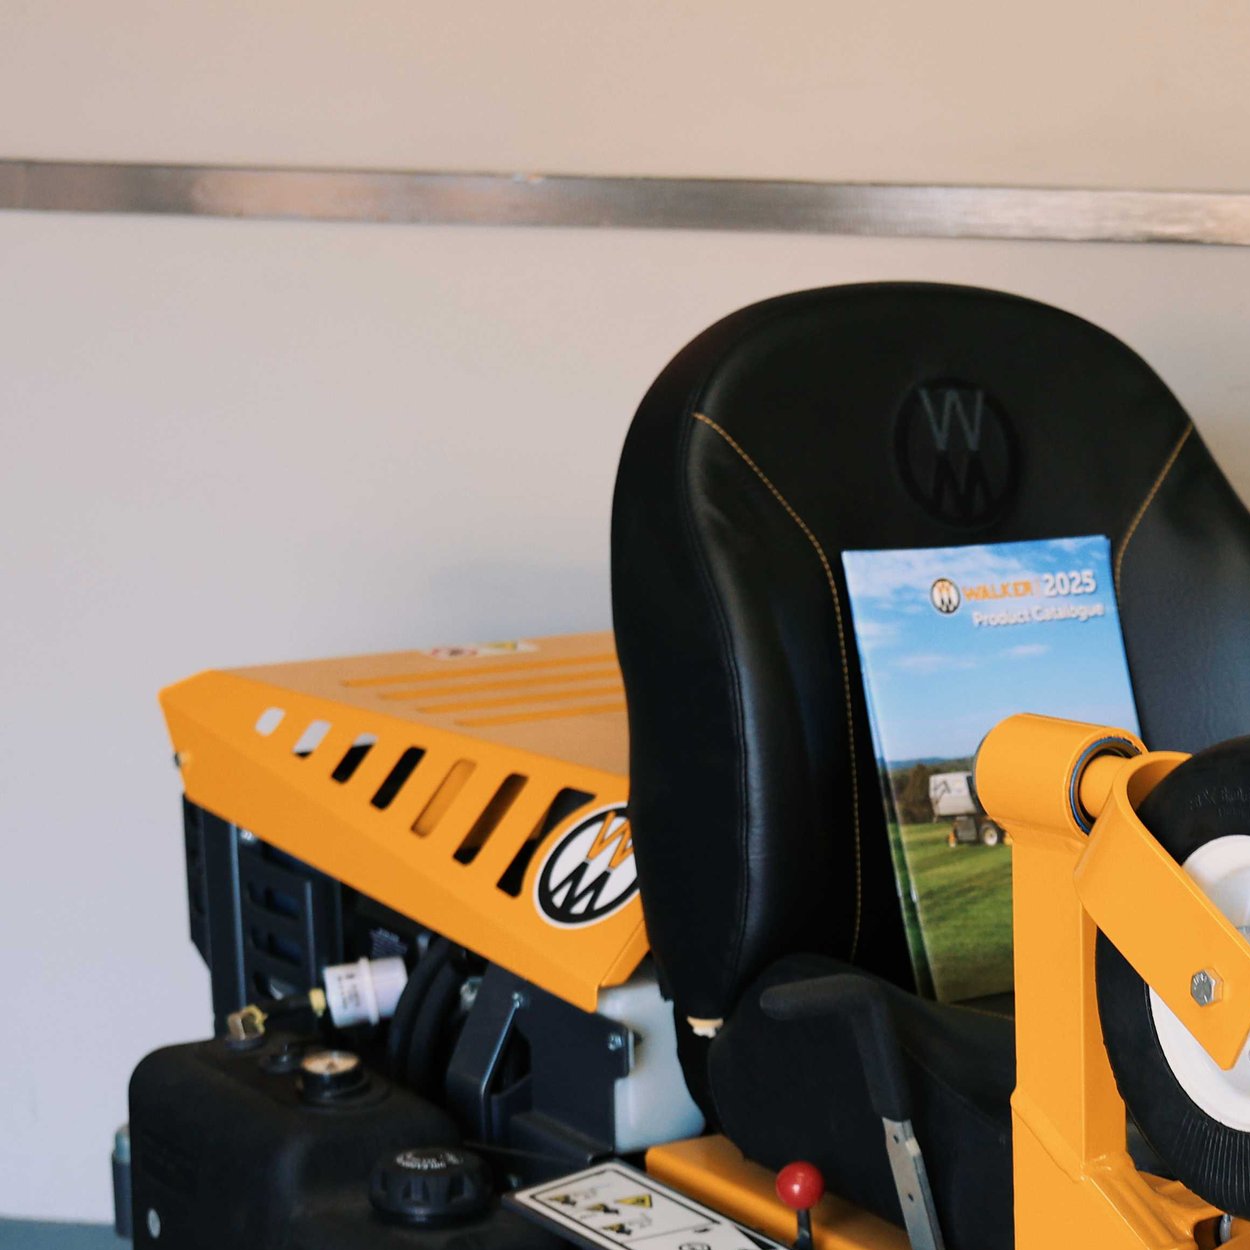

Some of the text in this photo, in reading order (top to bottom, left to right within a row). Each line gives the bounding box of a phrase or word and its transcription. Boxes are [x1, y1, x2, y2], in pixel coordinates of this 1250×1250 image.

[961, 569, 1098, 602] WALKER 2025
[973, 602, 1106, 627] Product Catalogue
